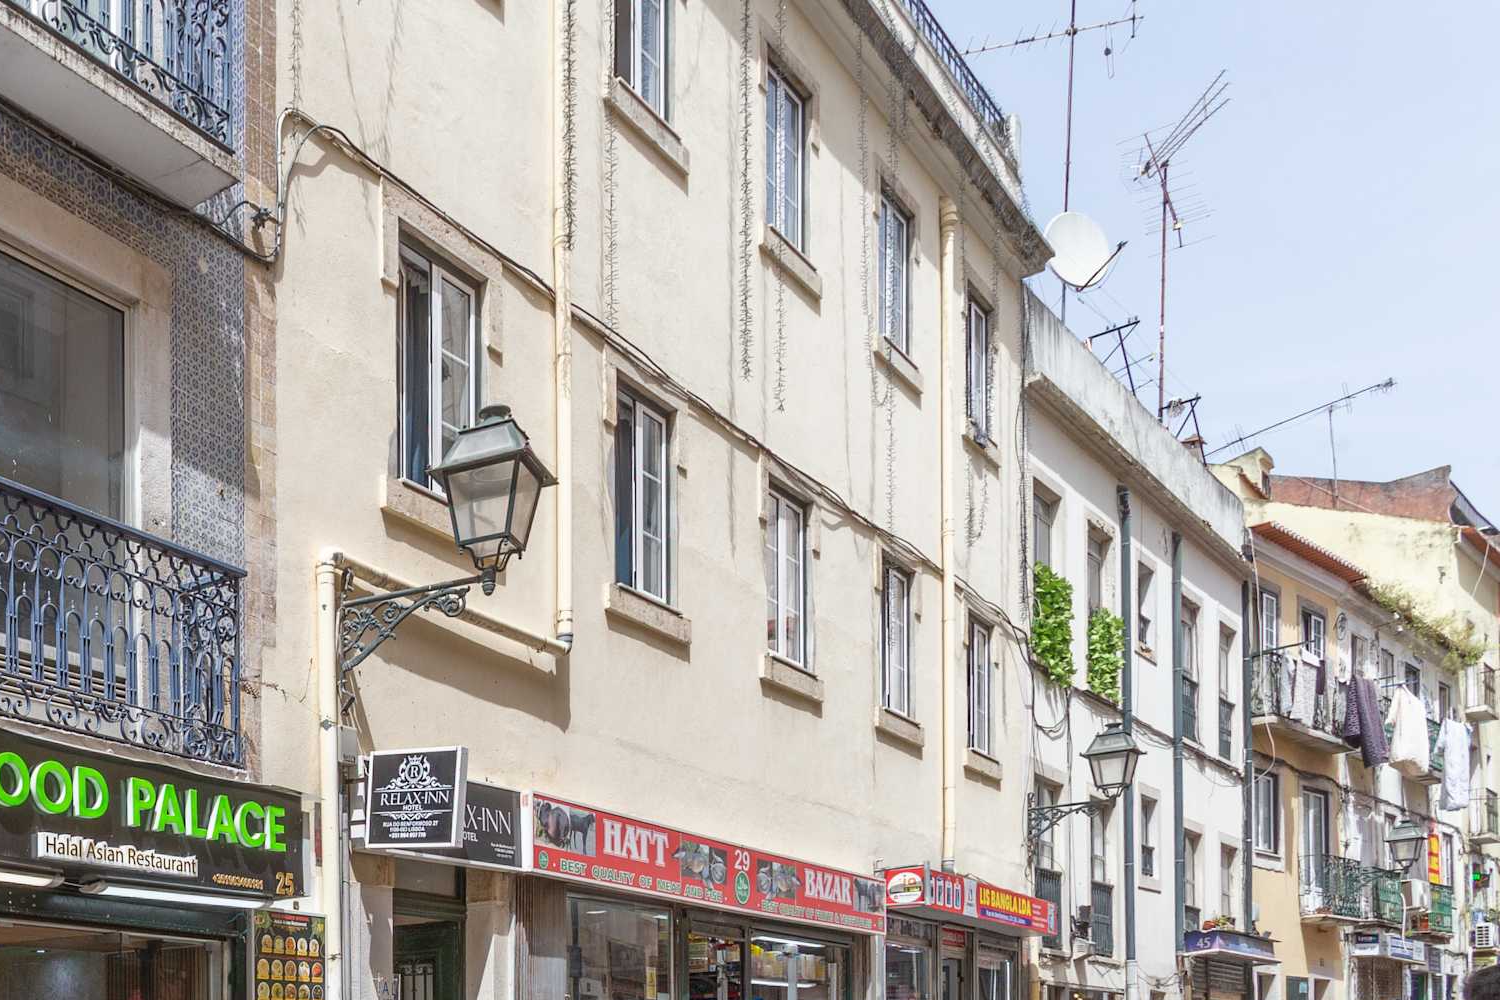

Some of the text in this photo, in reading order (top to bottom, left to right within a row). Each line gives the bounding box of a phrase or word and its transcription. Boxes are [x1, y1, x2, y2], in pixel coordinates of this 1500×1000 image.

[411, 766, 419, 778] R
[380, 790, 450, 806] RELAX-INN
[403, 804, 423, 812] HOTEL
[126, 776, 287, 853] PALACE
[45, 835, 197, 875] Halal Asian Restaurant
[603, 819, 669, 867] HATT
[734, 849, 750, 871] 29
[804, 868, 852, 906] BAZAR
[276, 872, 294, 896] 25
[560, 858, 587, 876] BEST
[592, 865, 635, 886] QUALITY
[639, 875, 652, 888] OF
[980, 887, 991, 906] LIS
[991, 890, 1019, 914] BANGLA
[1019, 896, 1032, 917] LDA
[1197, 937, 1211, 949] 45
